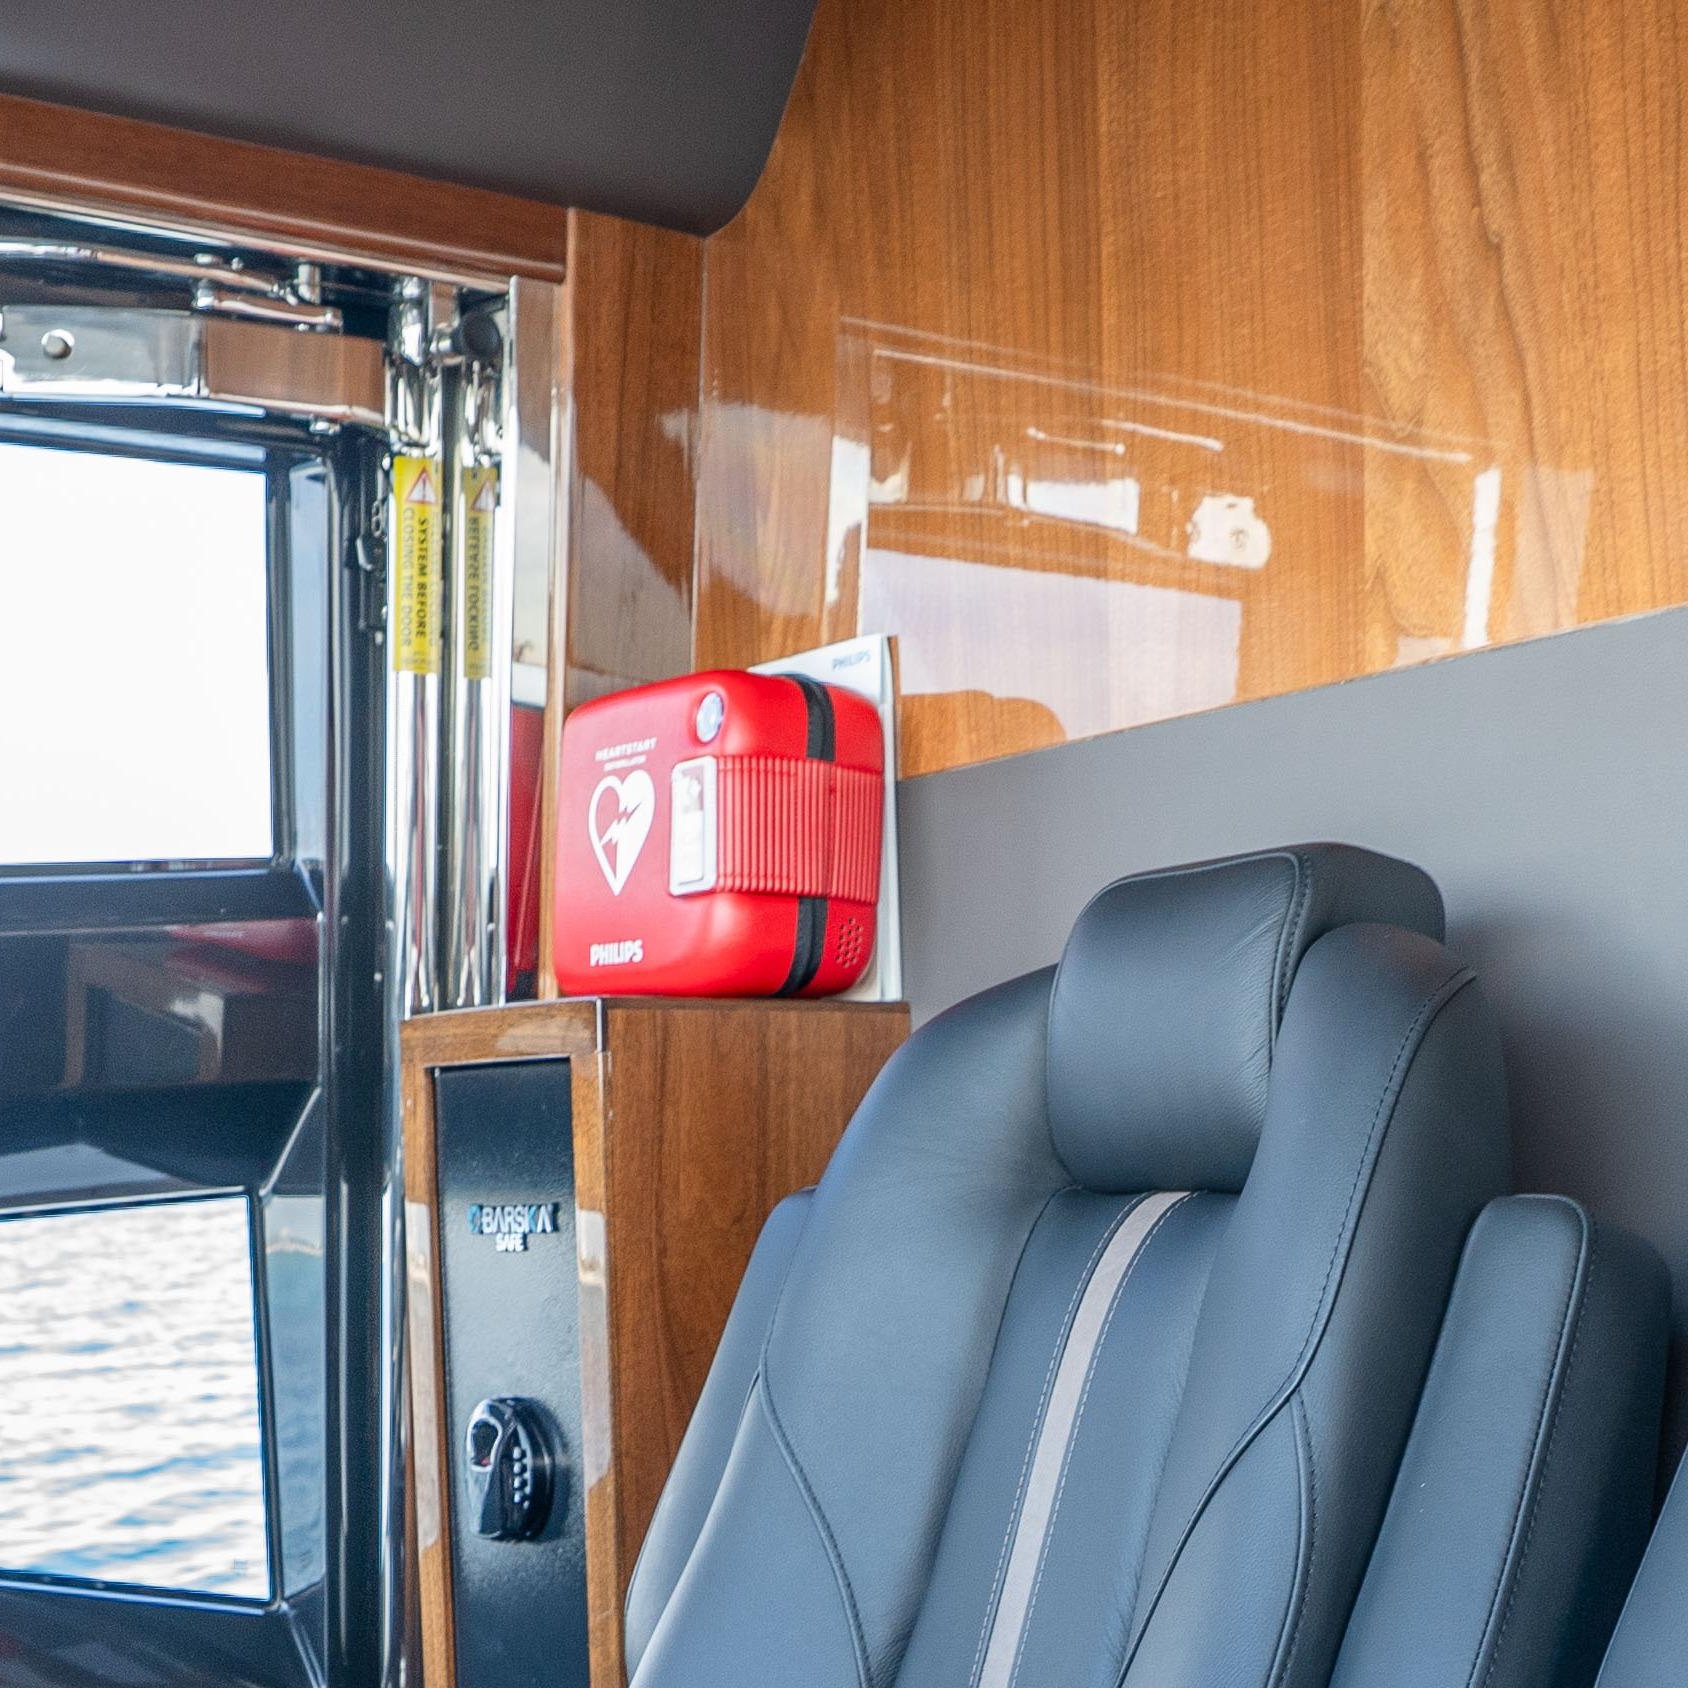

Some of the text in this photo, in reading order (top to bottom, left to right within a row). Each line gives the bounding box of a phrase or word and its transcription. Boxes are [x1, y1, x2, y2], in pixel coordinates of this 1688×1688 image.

[400, 507, 415, 648] CLOSING THE DOOR
[416, 517, 429, 639] SYSTEM BEFORE
[831, 648, 872, 671] PHILIPS
[589, 939, 644, 967] PHILIPS
[481, 1204, 553, 1234] BARSKA
[495, 1232, 525, 1252] SAFE
